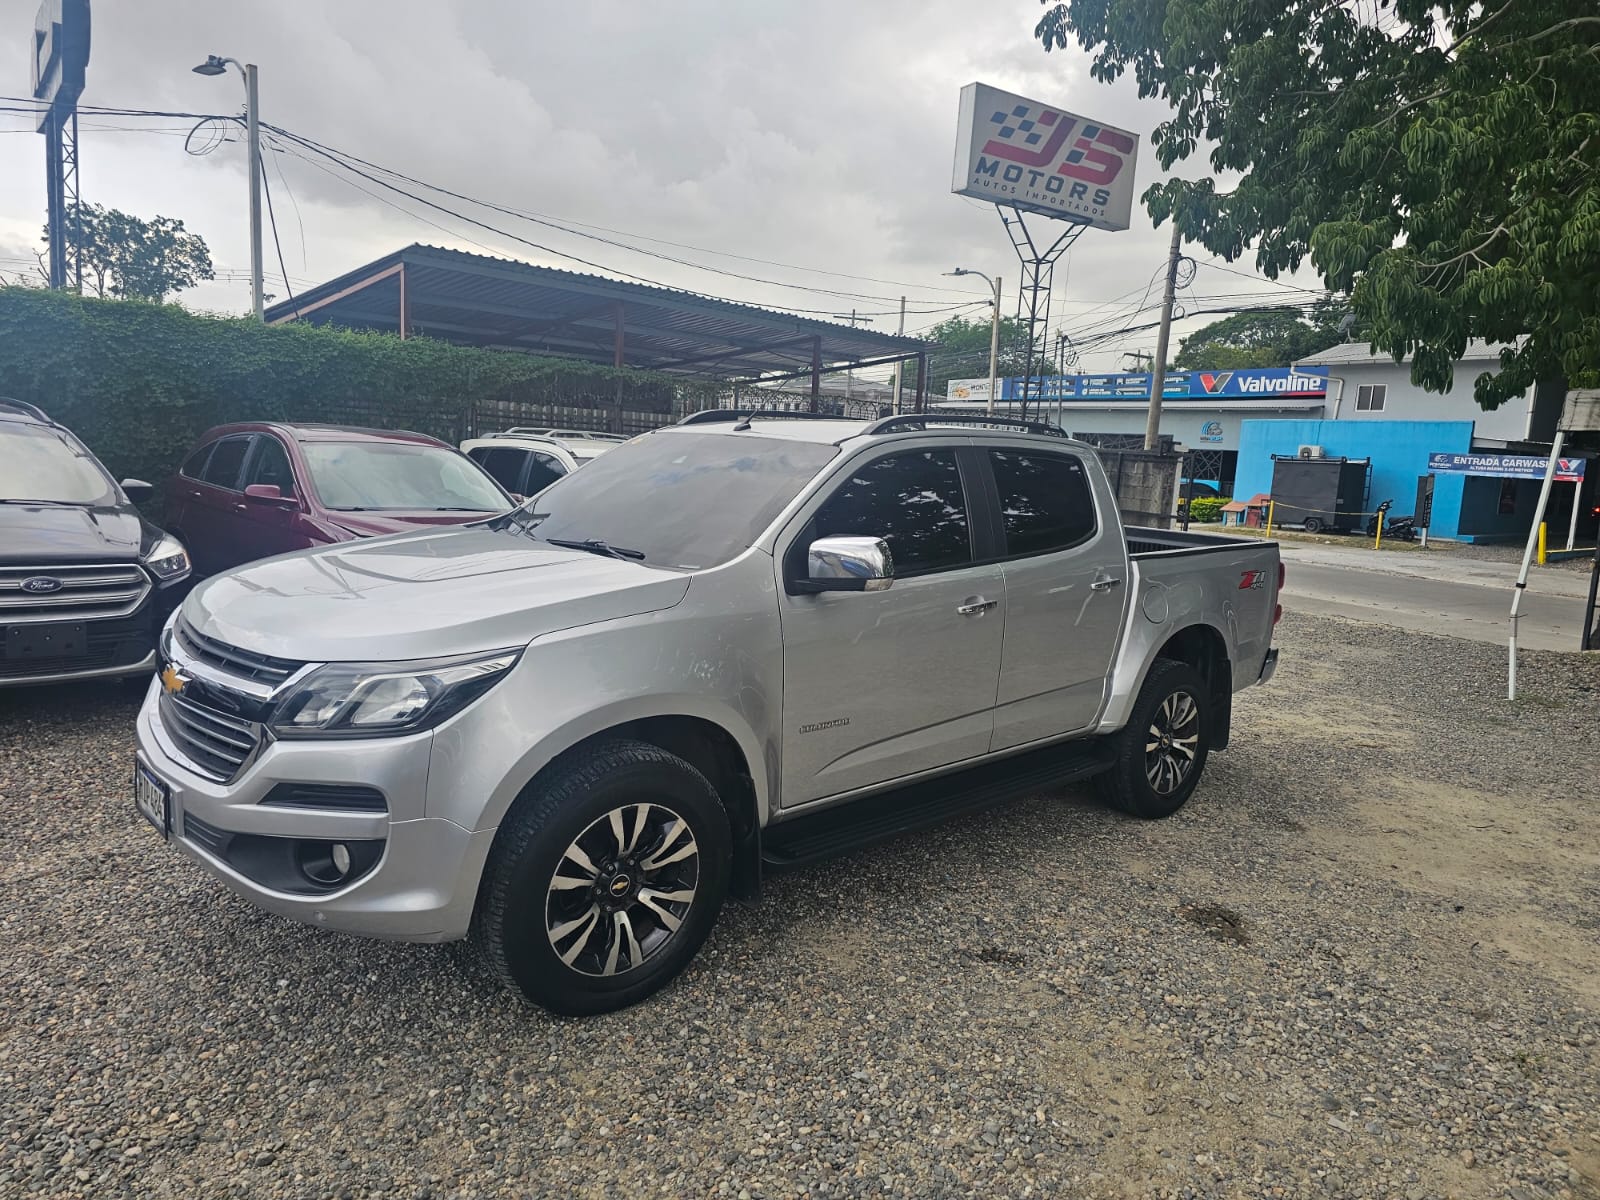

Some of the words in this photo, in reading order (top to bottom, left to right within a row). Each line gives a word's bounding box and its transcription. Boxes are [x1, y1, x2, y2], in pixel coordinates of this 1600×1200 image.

[975, 156, 1111, 206] MOTORS
[973, 178, 1016, 194] AUTOS
[1026, 190, 1105, 217] IMPORTADOS
[1238, 375, 1321, 393] Valvoline
[1453, 456, 1499, 466] ENTRADA
[30, 580, 55, 590] Ford
